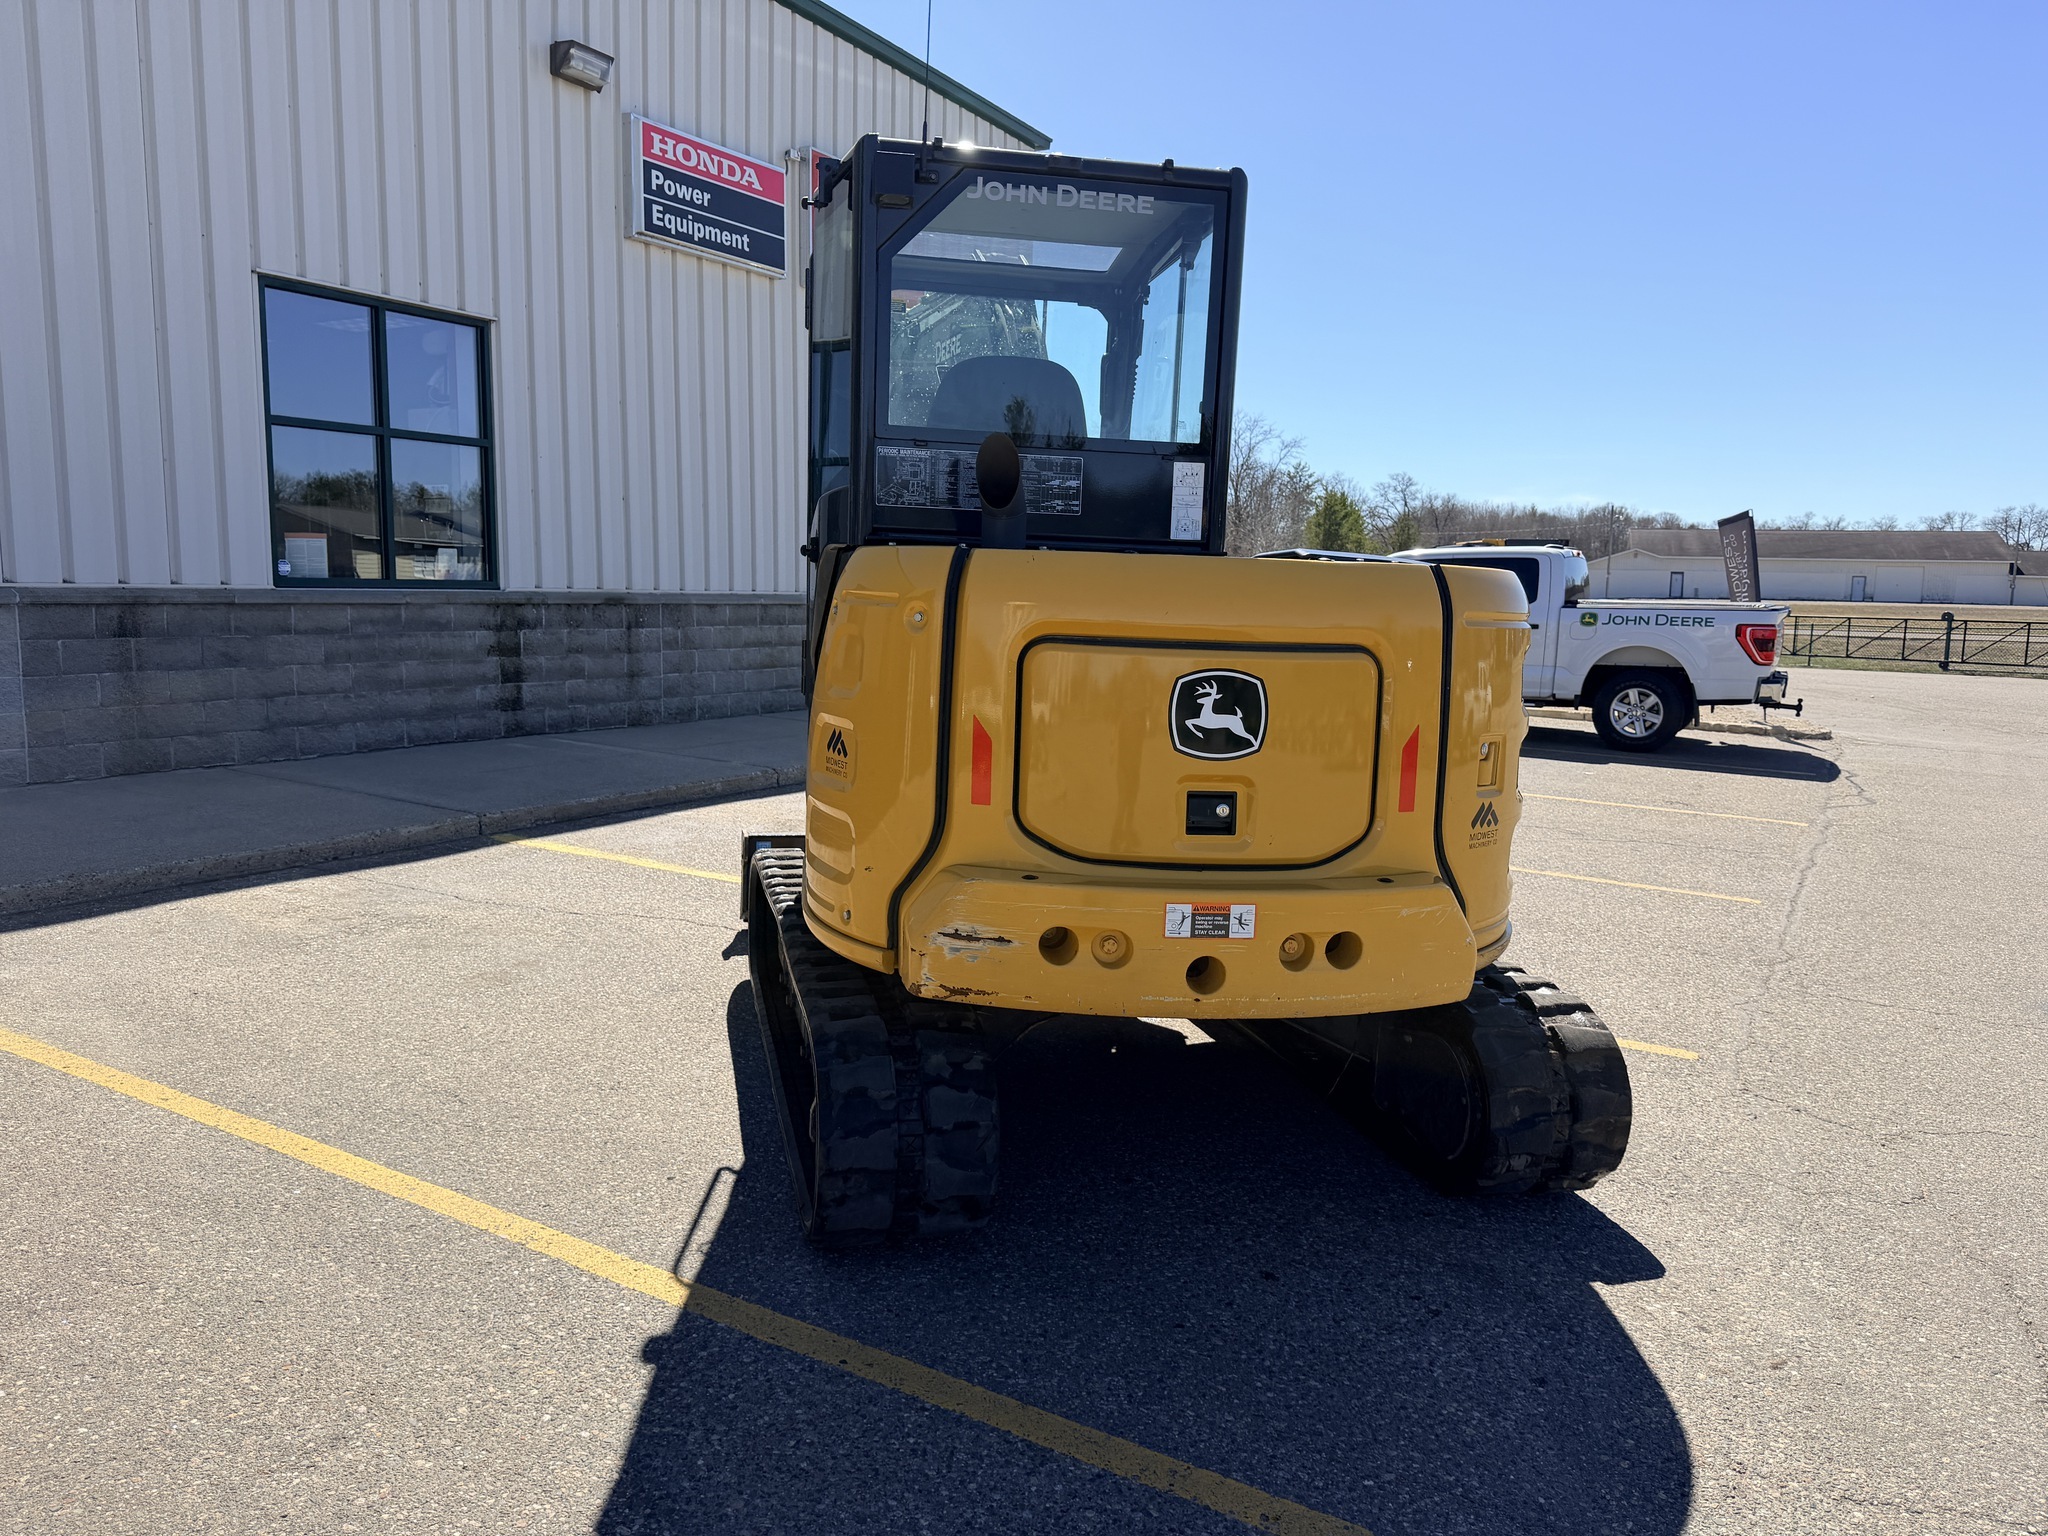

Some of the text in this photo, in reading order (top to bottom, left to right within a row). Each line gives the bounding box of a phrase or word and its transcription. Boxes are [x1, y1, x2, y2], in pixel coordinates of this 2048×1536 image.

[650, 131, 763, 191] HONDA
[651, 169, 711, 207] Power
[966, 176, 1155, 215] JOHN DEERE
[651, 203, 750, 252] Equipment
[1601, 613, 1716, 627] JOHN DEERE
[825, 756, 848, 770] MIDWEST
[1469, 829, 1498, 842] MIDWEST
